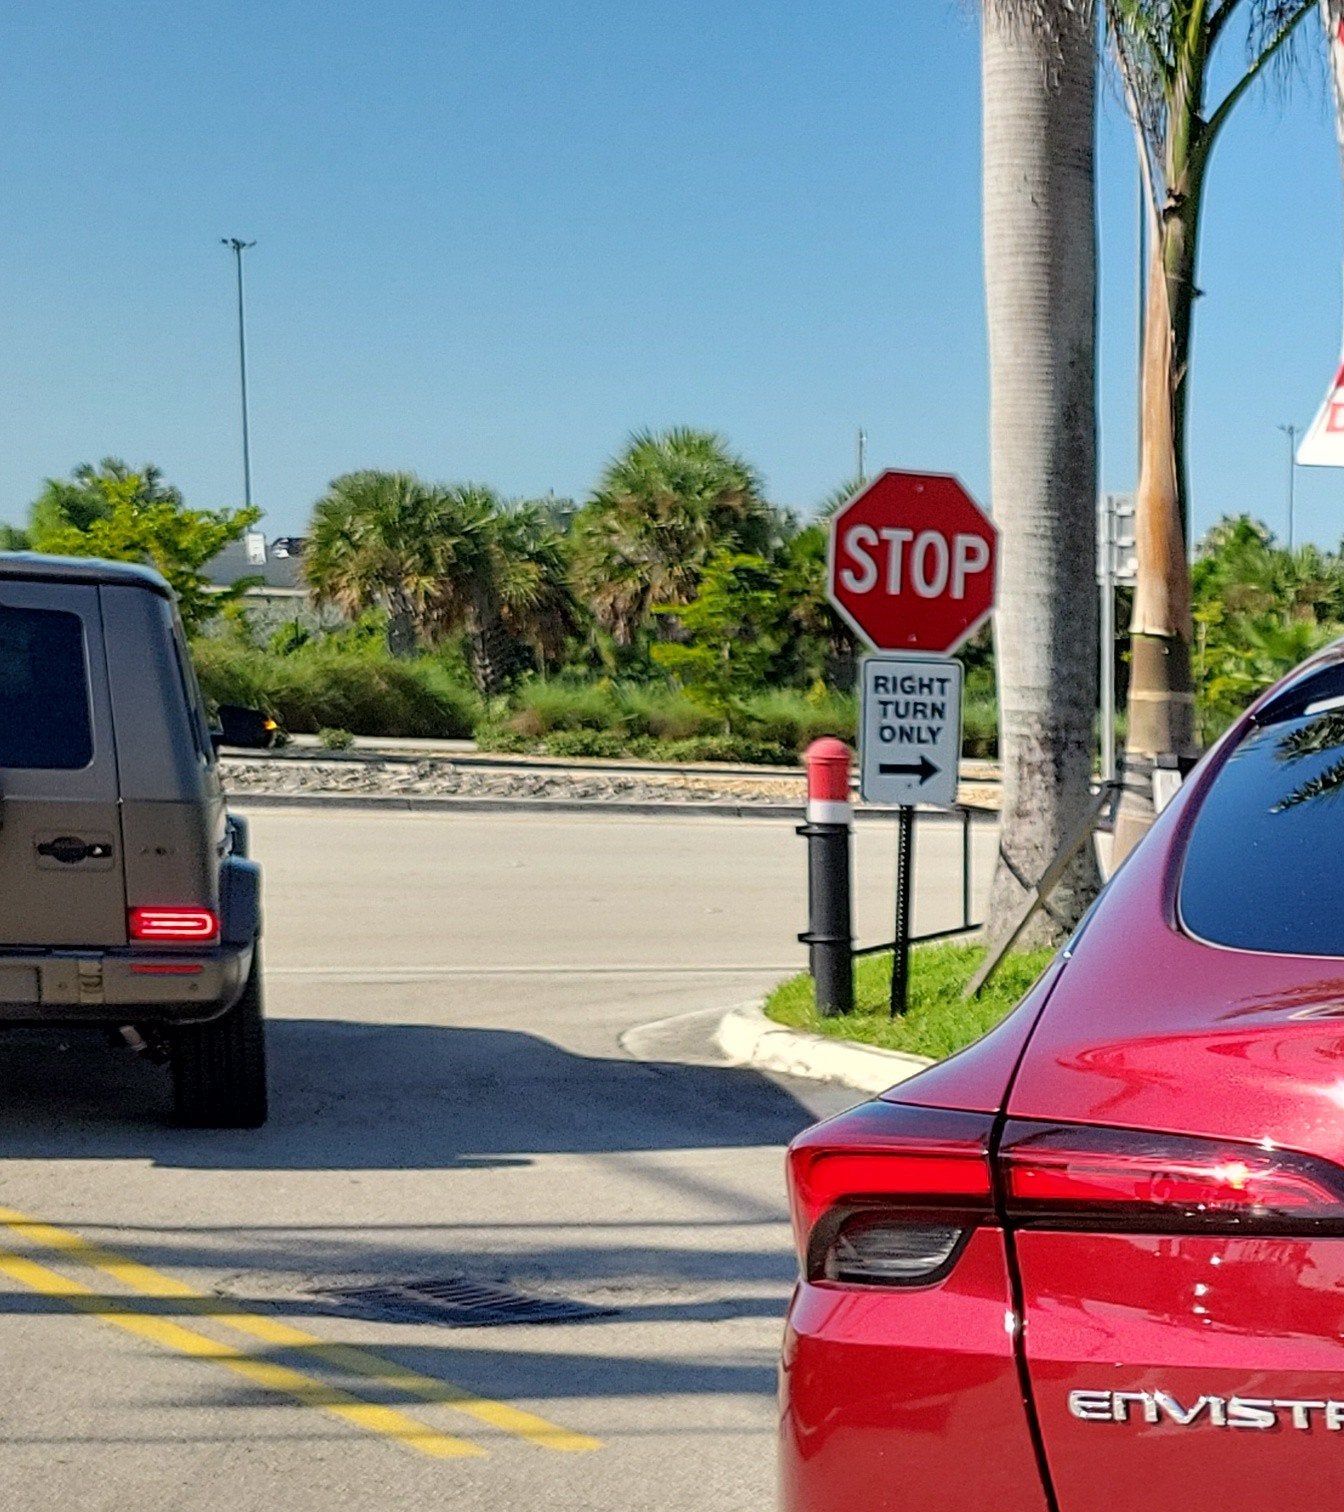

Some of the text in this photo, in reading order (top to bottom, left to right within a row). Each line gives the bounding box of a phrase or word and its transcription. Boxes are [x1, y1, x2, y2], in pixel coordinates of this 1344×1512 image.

[839, 524, 990, 599] STOP
[874, 675, 951, 696] RIGHT
[879, 700, 946, 720] TURN
[880, 725, 943, 744] ONLY
